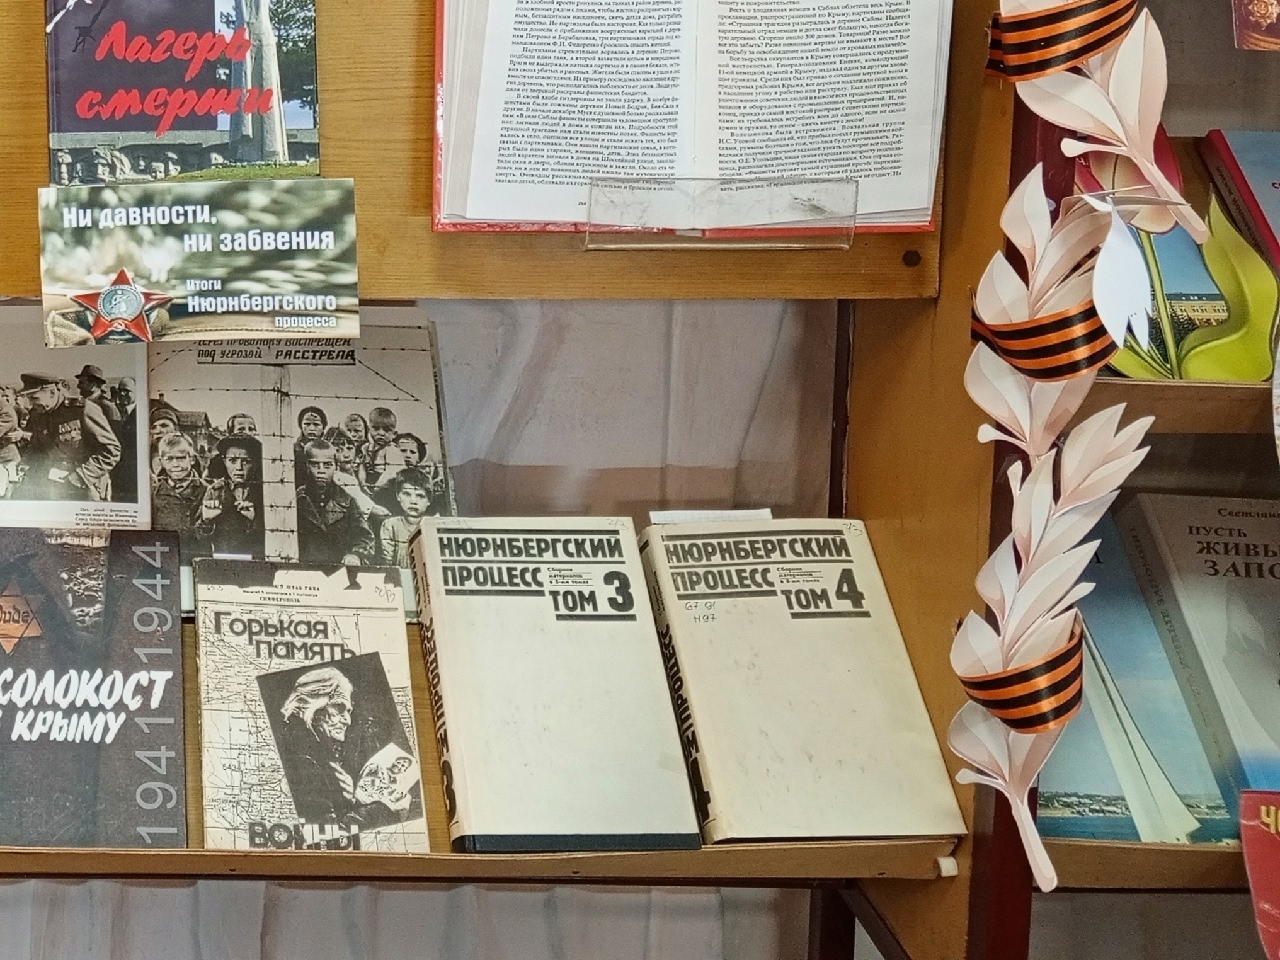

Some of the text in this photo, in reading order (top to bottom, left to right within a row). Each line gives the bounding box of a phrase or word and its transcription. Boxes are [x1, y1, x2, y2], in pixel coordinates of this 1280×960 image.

[95, 21, 253, 83] Лагерь
[75, 88, 274, 138] смерти
[63, 203, 217, 229] Ни давности,
[183, 229, 335, 252] ни забвения
[187, 293, 337, 314] Нюрнбергского
[274, 314, 337, 329] процесса
[275, 350, 356, 361] РАССТРЕЛА
[1188, 525, 1248, 538] ПУСТЬ
[439, 537, 624, 559] НЮРНБЕРГСКИЙ
[664, 536, 852, 564] НЮРНБЕРГСКИЙ
[441, 566, 545, 589] ПРОЦЕСС
[673, 567, 775, 592] ПРОЦЕСС
[780, 569, 865, 611] ТОМ 4
[549, 590, 599, 612] ТОМ
[603, 571, 636, 613] 3
[214, 612, 329, 645] Горькая
[255, 640, 357, 662] память
[131, 541, 178, 844] 1941 1944
[11, 710, 126, 744] КРЫМУ
